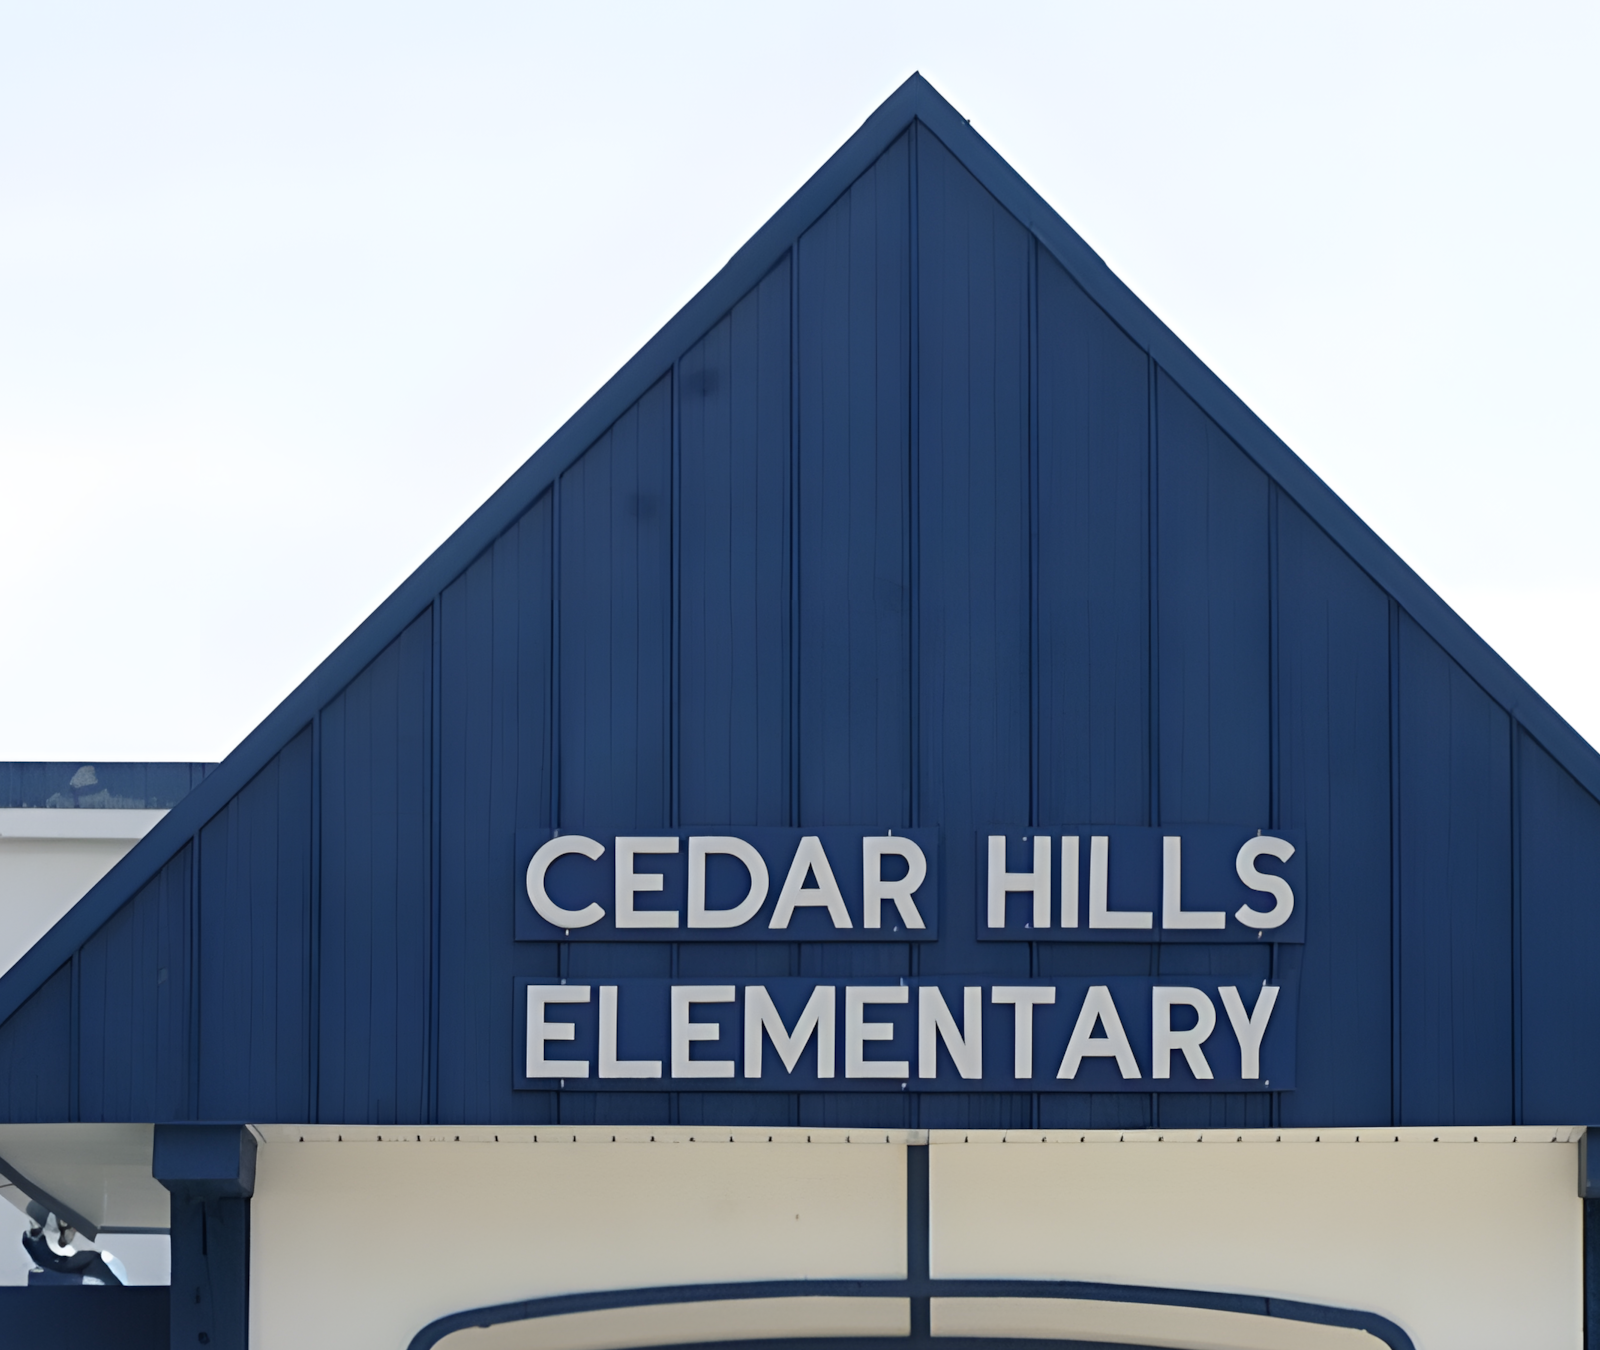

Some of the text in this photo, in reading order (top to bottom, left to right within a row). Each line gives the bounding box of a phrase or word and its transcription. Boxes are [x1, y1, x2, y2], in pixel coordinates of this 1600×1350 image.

[525, 834, 1297, 930] CEDAR HILLS
[525, 984, 1281, 1080] ELEMENTARY
